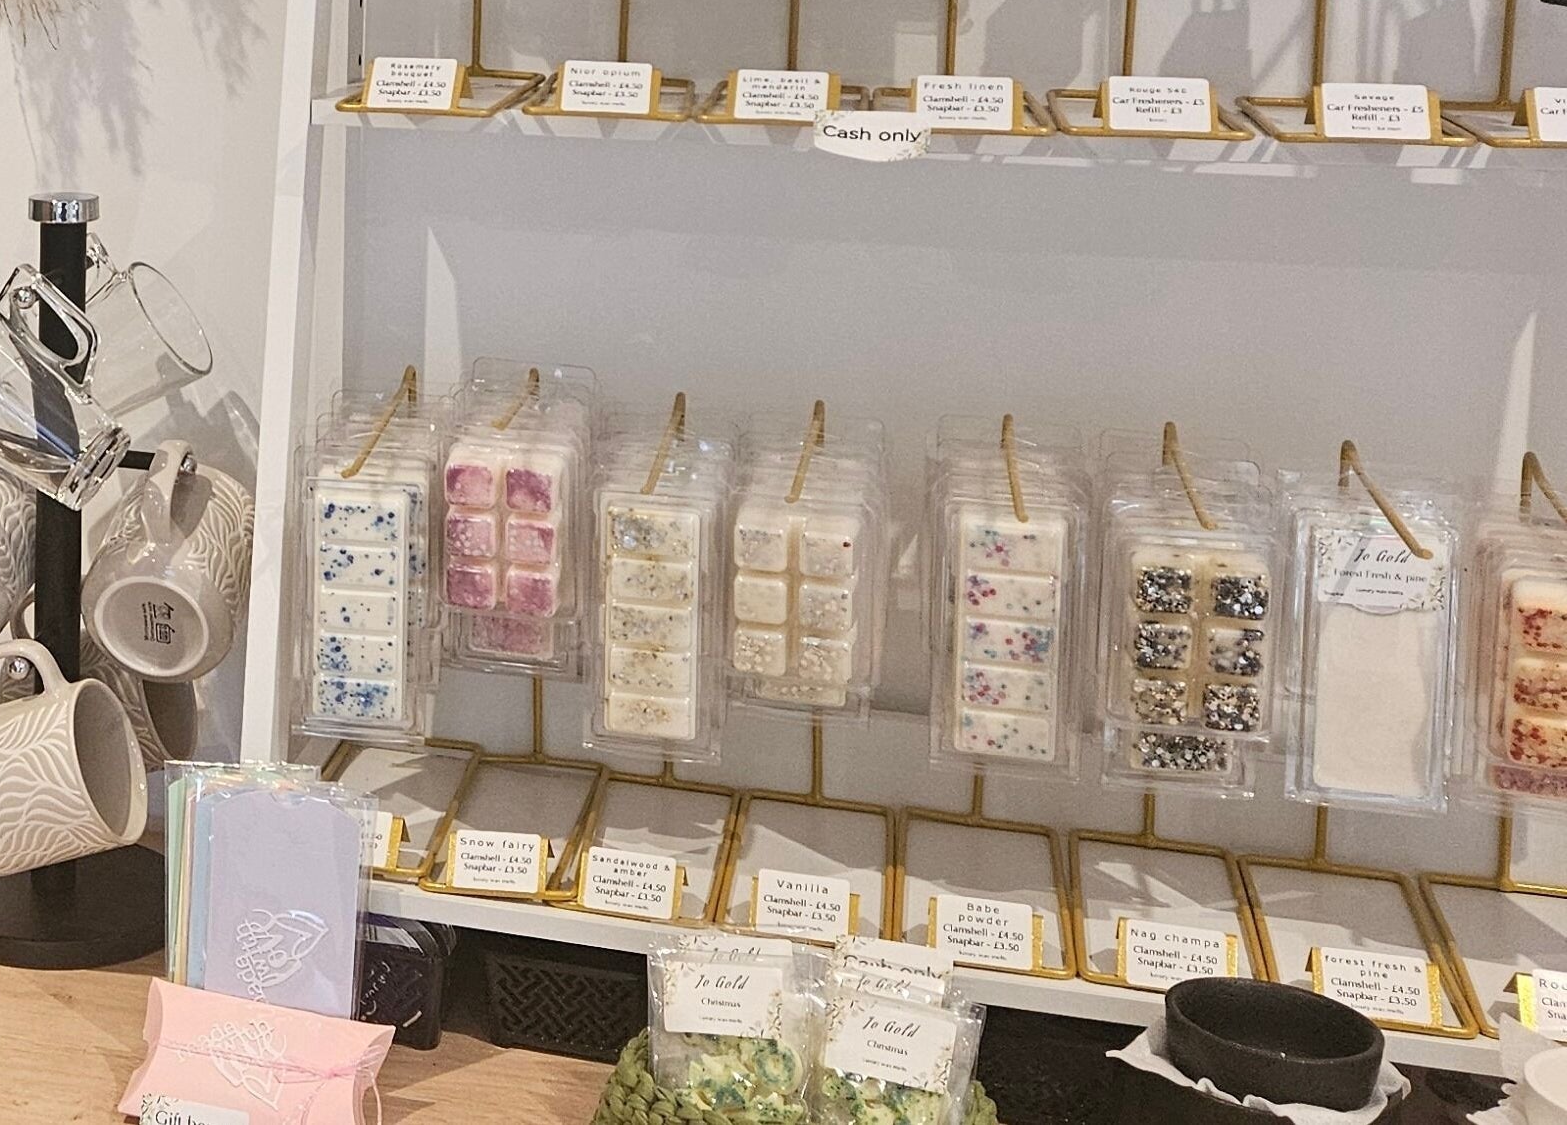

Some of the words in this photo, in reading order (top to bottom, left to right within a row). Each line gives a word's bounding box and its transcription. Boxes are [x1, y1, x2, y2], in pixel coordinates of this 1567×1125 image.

[376, 79, 416, 87] Clamshell
[569, 80, 610, 88] Clamshell
[572, 89, 606, 97] Snapbar
[742, 91, 785, 99] Clamshell
[1132, 97, 1183, 105] Fresheners
[823, 125, 871, 140] Cash
[878, 128, 921, 142] only
[1354, 548, 1370, 563] Jo
[1376, 549, 1411, 564] Gold
[1334, 569, 1363, 578] Forest
[1365, 570, 1392, 580] Fresh
[460, 838, 494, 847] Snow
[502, 840, 535, 851] fairy
[461, 852, 500, 862] Clamshell
[509, 856, 532, 864] £4.50
[592, 855, 658, 870] Sandalwood
[464, 862, 496, 872] Snapbar
[504, 866, 527, 874] £3.50
[614, 868, 647, 877] amber
[592, 875, 634, 887] Clamshell
[642, 882, 666, 892] £4.50
[777, 879, 829, 894] Vanilla
[595, 885, 629, 897] Snapbar
[637, 892, 661, 903] £3.50
[763, 894, 807, 907] Clamshell
[816, 903, 841, 912] £4.50
[967, 903, 1000, 914] Babe
[766, 905, 802, 918] Snapbar
[811, 913, 836, 922] £3.50
[958, 914, 1009, 927] powder
[943, 923, 988, 936] Clamshell
[998, 931, 1024, 941] £4.50
[1130, 929, 1156, 941] Nag
[1165, 934, 1220, 949] champa
[947, 935, 984, 947] Snapbar
[994, 942, 1020, 952] £3.50
[1133, 945, 1180, 959] Clamshell
[1191, 954, 1218, 964] £4.50
[1137, 957, 1177, 969] Snapbar
[1187, 964, 1214, 975] £3.50
[1325, 955, 1365, 967] forest
[1372, 960, 1407, 972] fresh
[1360, 970, 1389, 978] pine
[694, 975, 709, 989] Jo
[716, 975, 750, 990] Gold
[1331, 977, 1381, 991] Clamshell
[1392, 985, 1420, 996] £4.50
[701, 997, 741, 1008] Christmas
[1336, 989, 1377, 1002] Snapbar
[1389, 996, 1417, 1007] £3.50
[862, 1016, 877, 1029] Jo
[883, 1021, 920, 1038] Gold
[867, 1039, 908, 1056] Christmas
